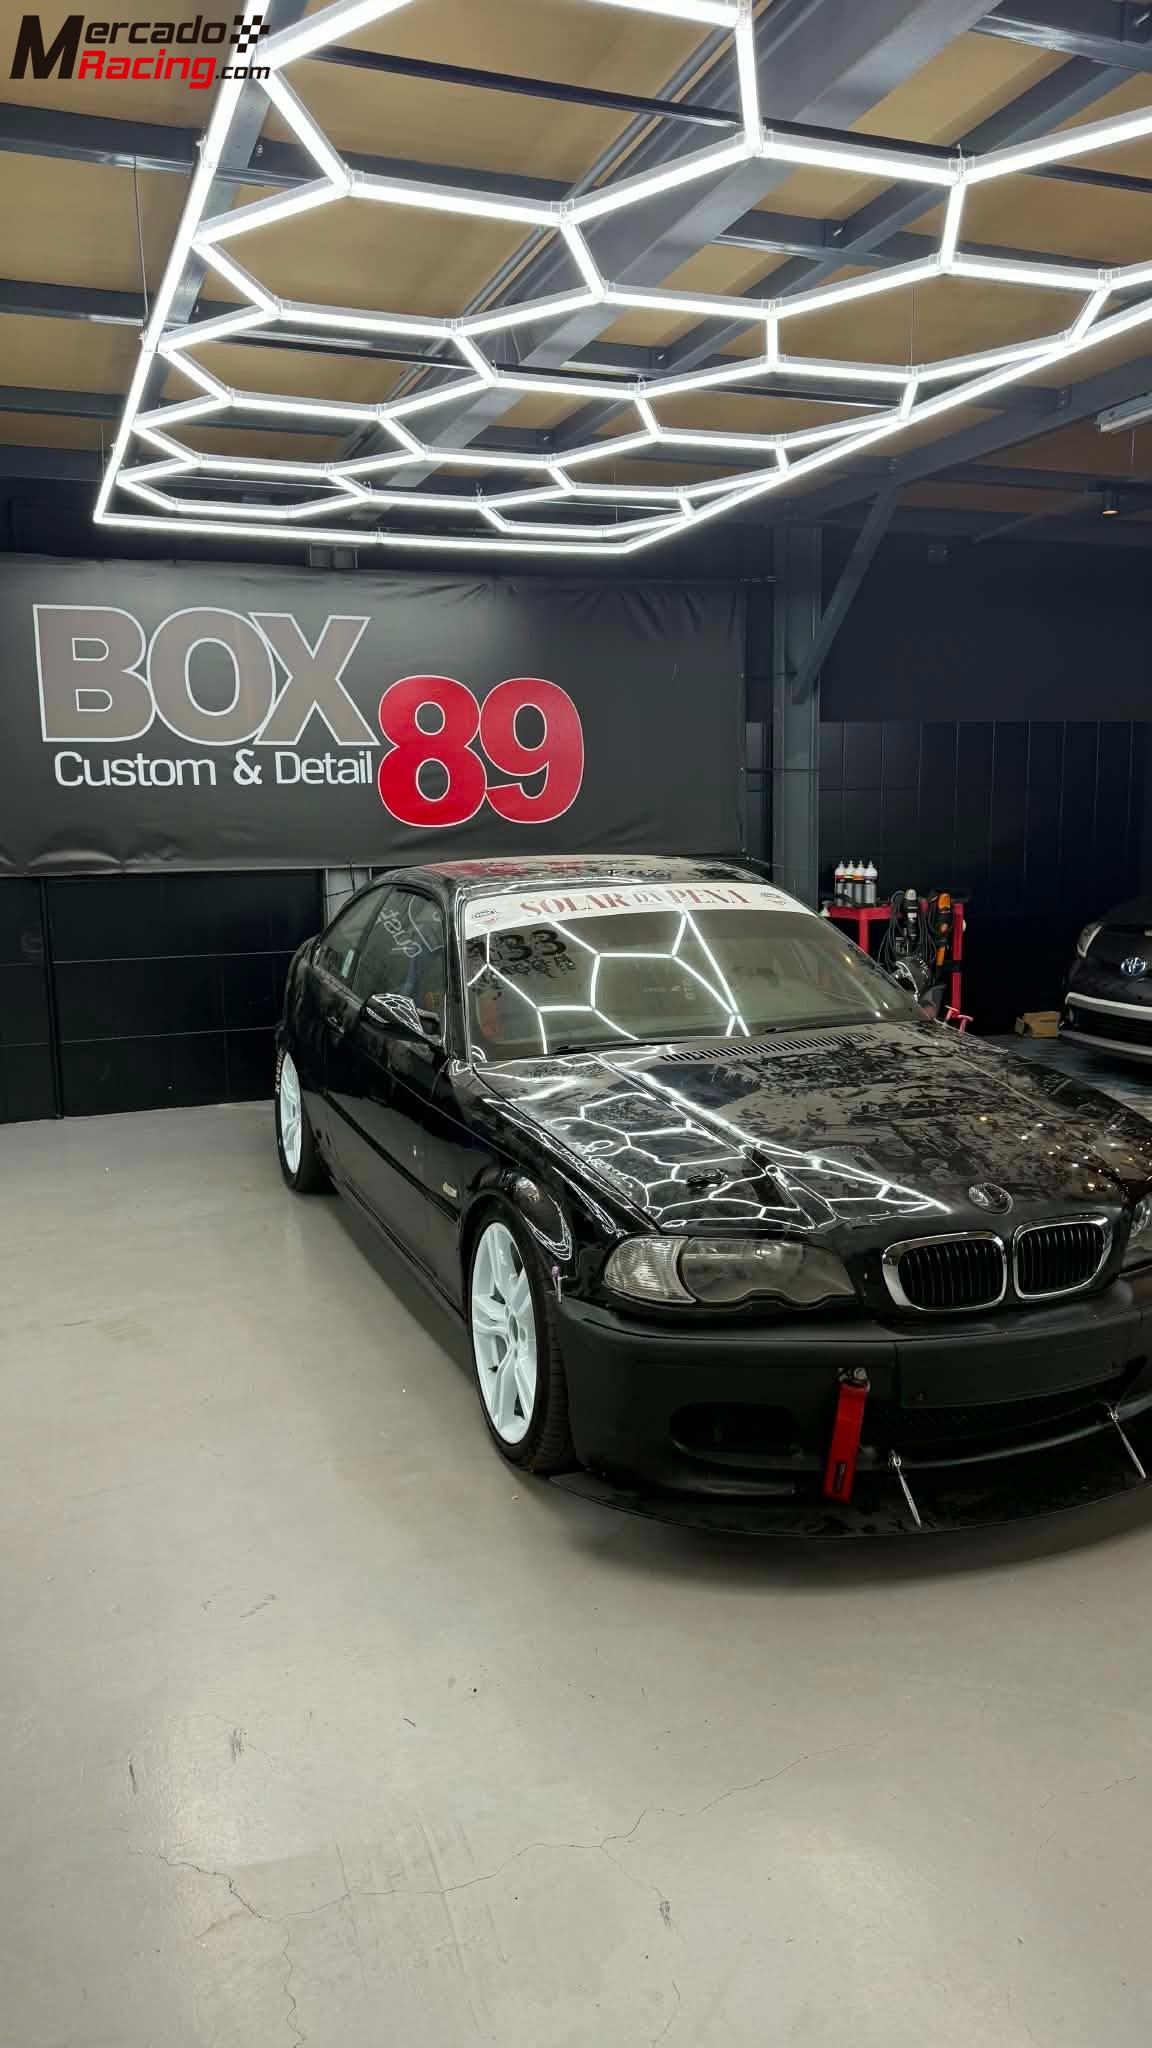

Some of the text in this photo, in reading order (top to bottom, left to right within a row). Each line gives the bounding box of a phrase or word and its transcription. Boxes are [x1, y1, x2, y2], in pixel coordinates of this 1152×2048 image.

[33, 604, 380, 746] BOX
[54, 749, 373, 786] Custom & Detail
[378, 675, 585, 828] 89
[519, 893, 632, 918] SOLAR
